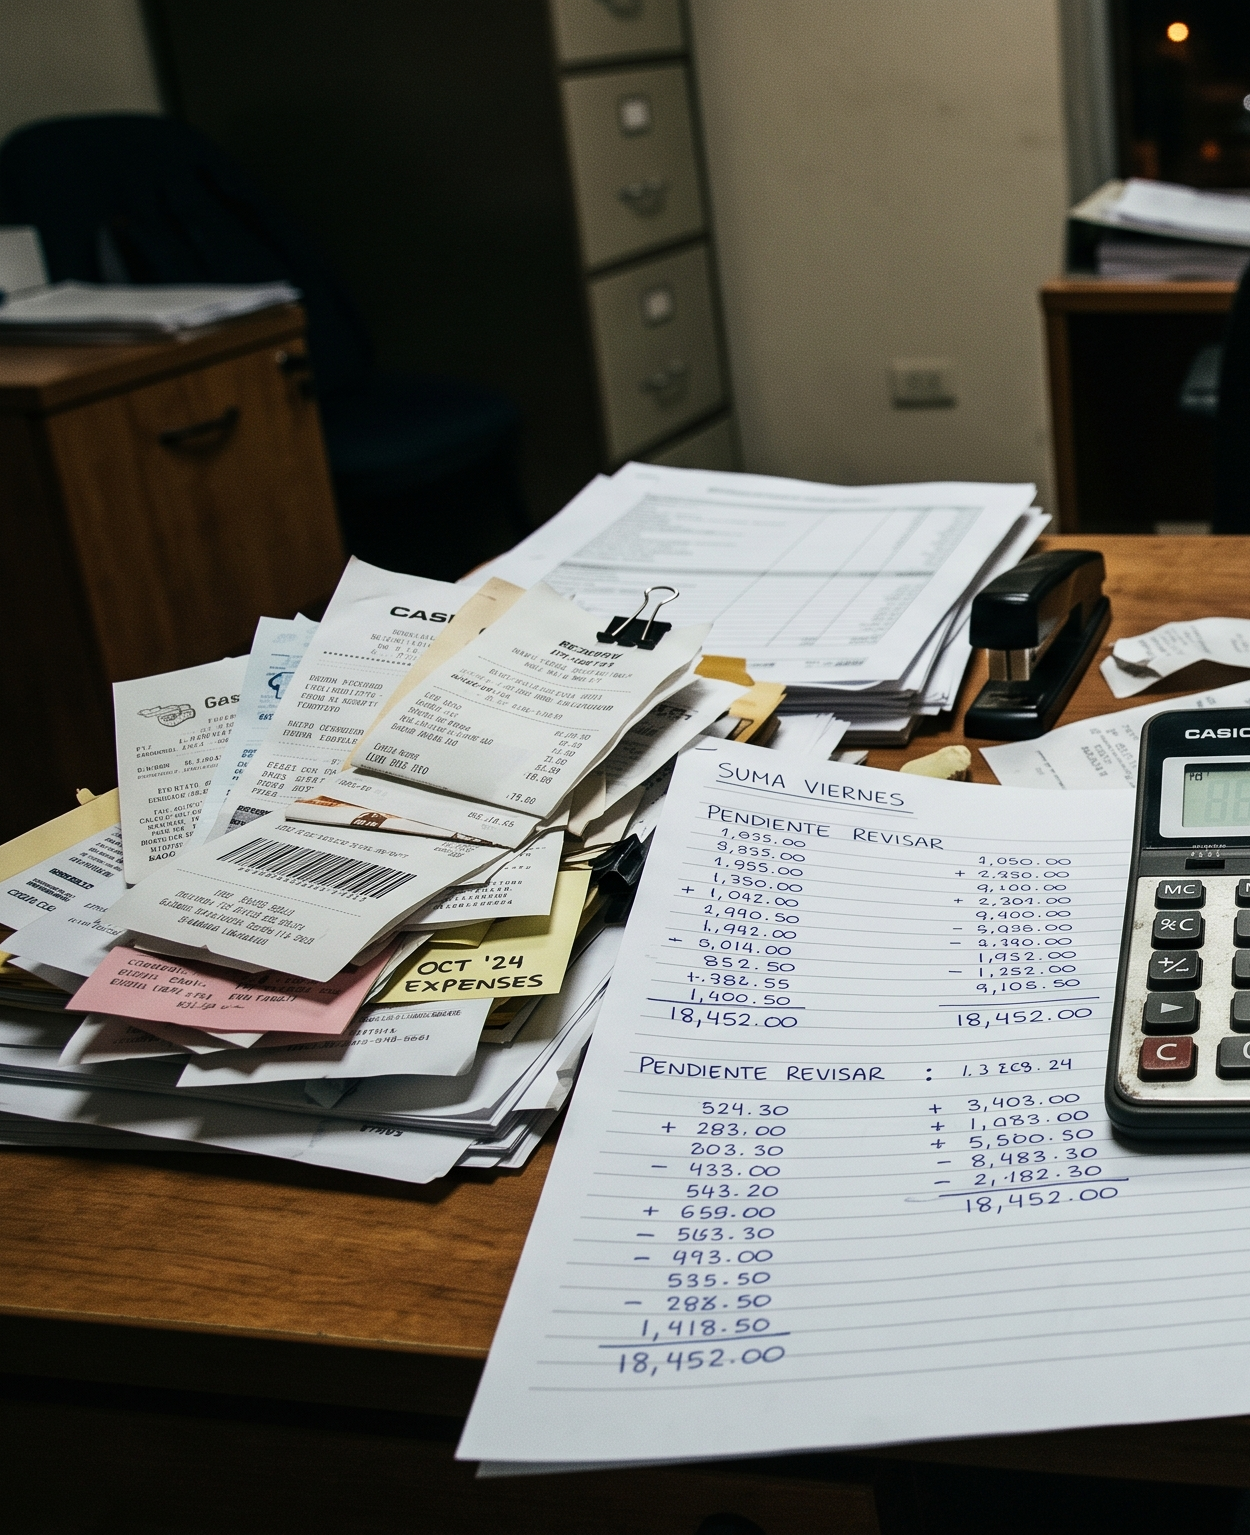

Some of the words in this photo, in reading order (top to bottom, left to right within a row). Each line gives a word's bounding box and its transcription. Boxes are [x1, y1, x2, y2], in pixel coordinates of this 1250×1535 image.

[390, 606, 455, 624] CAS
[717, 762, 786, 789] SUMA
[804, 779, 905, 807] VIERNES
[707, 804, 831, 838] PENDIENTE
[853, 827, 944, 851] REVISAR
[713, 872, 803, 893] 1,350.00
[1164, 883, 1196, 895] MC
[710, 888, 799, 908] 1,042.00
[417, 959, 472, 975] OCT
[485, 956, 524, 970] '24
[703, 955, 795, 972] 852.50
[979, 965, 1076, 978] 1,252.00
[404, 974, 543, 993] EXPENSES
[691, 988, 790, 1005] 1,400.50
[671, 1006, 798, 1028] 18,452.00
[957, 1008, 1092, 1029] 18,452.00
[1156, 1043, 1177, 1061] C
[639, 1056, 768, 1081] PENDIENTE
[786, 1065, 886, 1081] REVISAR
[702, 1101, 789, 1116] 524.30
[967, 1093, 1080, 1112] 3,403.00
[969, 1128, 1094, 1150] 5,500.50
[971, 1147, 1098, 1169] 8,483.30
[689, 1162, 780, 1177] 433.00
[686, 1184, 779, 1199] 543.20
[966, 1187, 1119, 1214] 18,452.00
[673, 1249, 773, 1266] 493.00
[667, 1271, 771, 1288] 535.50
[641, 1318, 770, 1342] 1,418.50
[619, 1346, 786, 1377] 18,452.00
